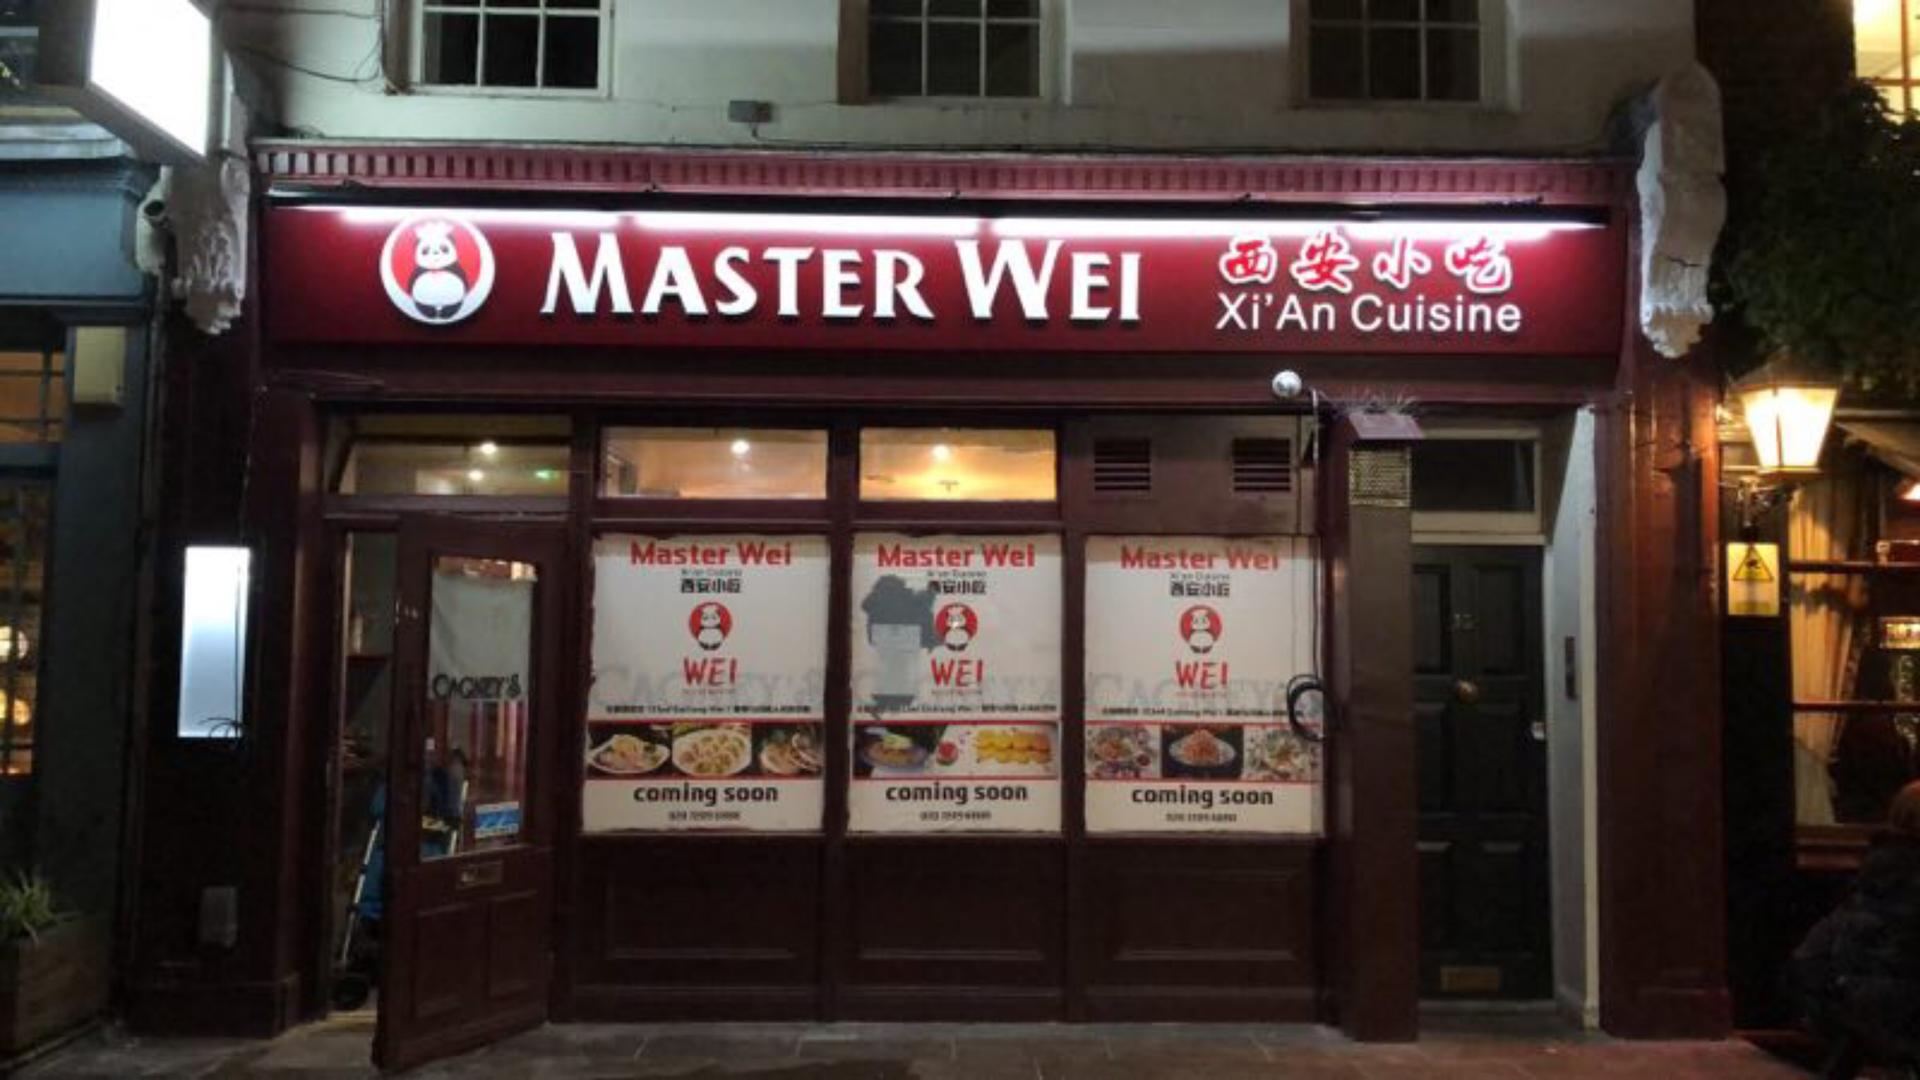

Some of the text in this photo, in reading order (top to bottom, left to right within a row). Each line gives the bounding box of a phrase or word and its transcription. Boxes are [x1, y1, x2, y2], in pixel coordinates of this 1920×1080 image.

[1219, 227, 1511, 293] 西安小吃
[540, 233, 1142, 321] MASTER WEI
[1216, 293, 1522, 332] Xi'An Cuisine
[631, 541, 791, 565] Master Wei
[877, 543, 1035, 567] Master Wei
[1120, 546, 1279, 570] Master Wei
[684, 657, 737, 687] WEI
[930, 659, 983, 687] WEI
[1175, 661, 1228, 690] WEI
[633, 782, 779, 807] coming soon
[885, 782, 1028, 805] coming soon
[1132, 785, 1273, 808] coming soon
